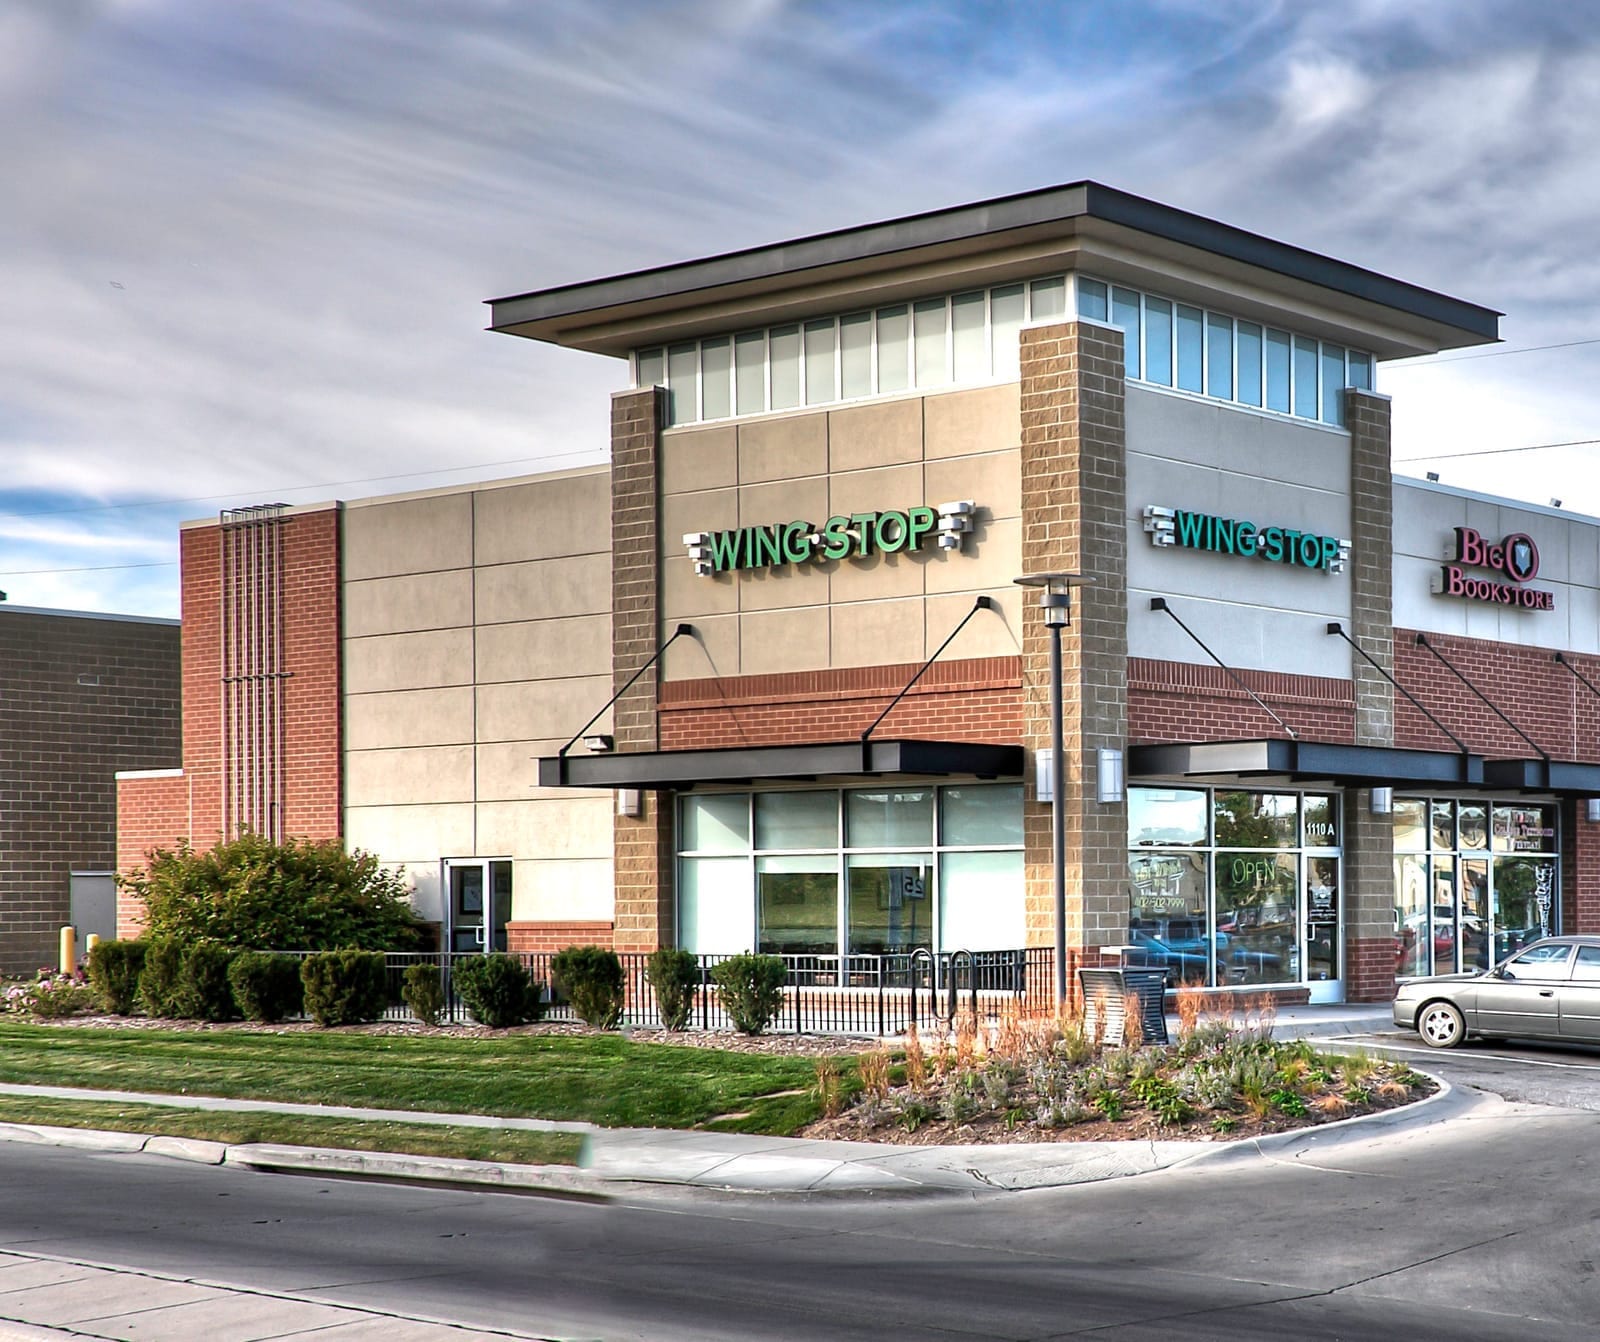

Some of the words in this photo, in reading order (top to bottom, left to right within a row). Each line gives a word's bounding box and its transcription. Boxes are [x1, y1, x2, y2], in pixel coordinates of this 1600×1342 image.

[709, 521, 813, 571] WING
[823, 506, 936, 560] STOP
[1176, 510, 1257, 556] WING
[1263, 527, 1338, 569] STOP
[1444, 566, 1555, 610] BOOKSTORE
[1231, 858, 1275, 885] OPEN
